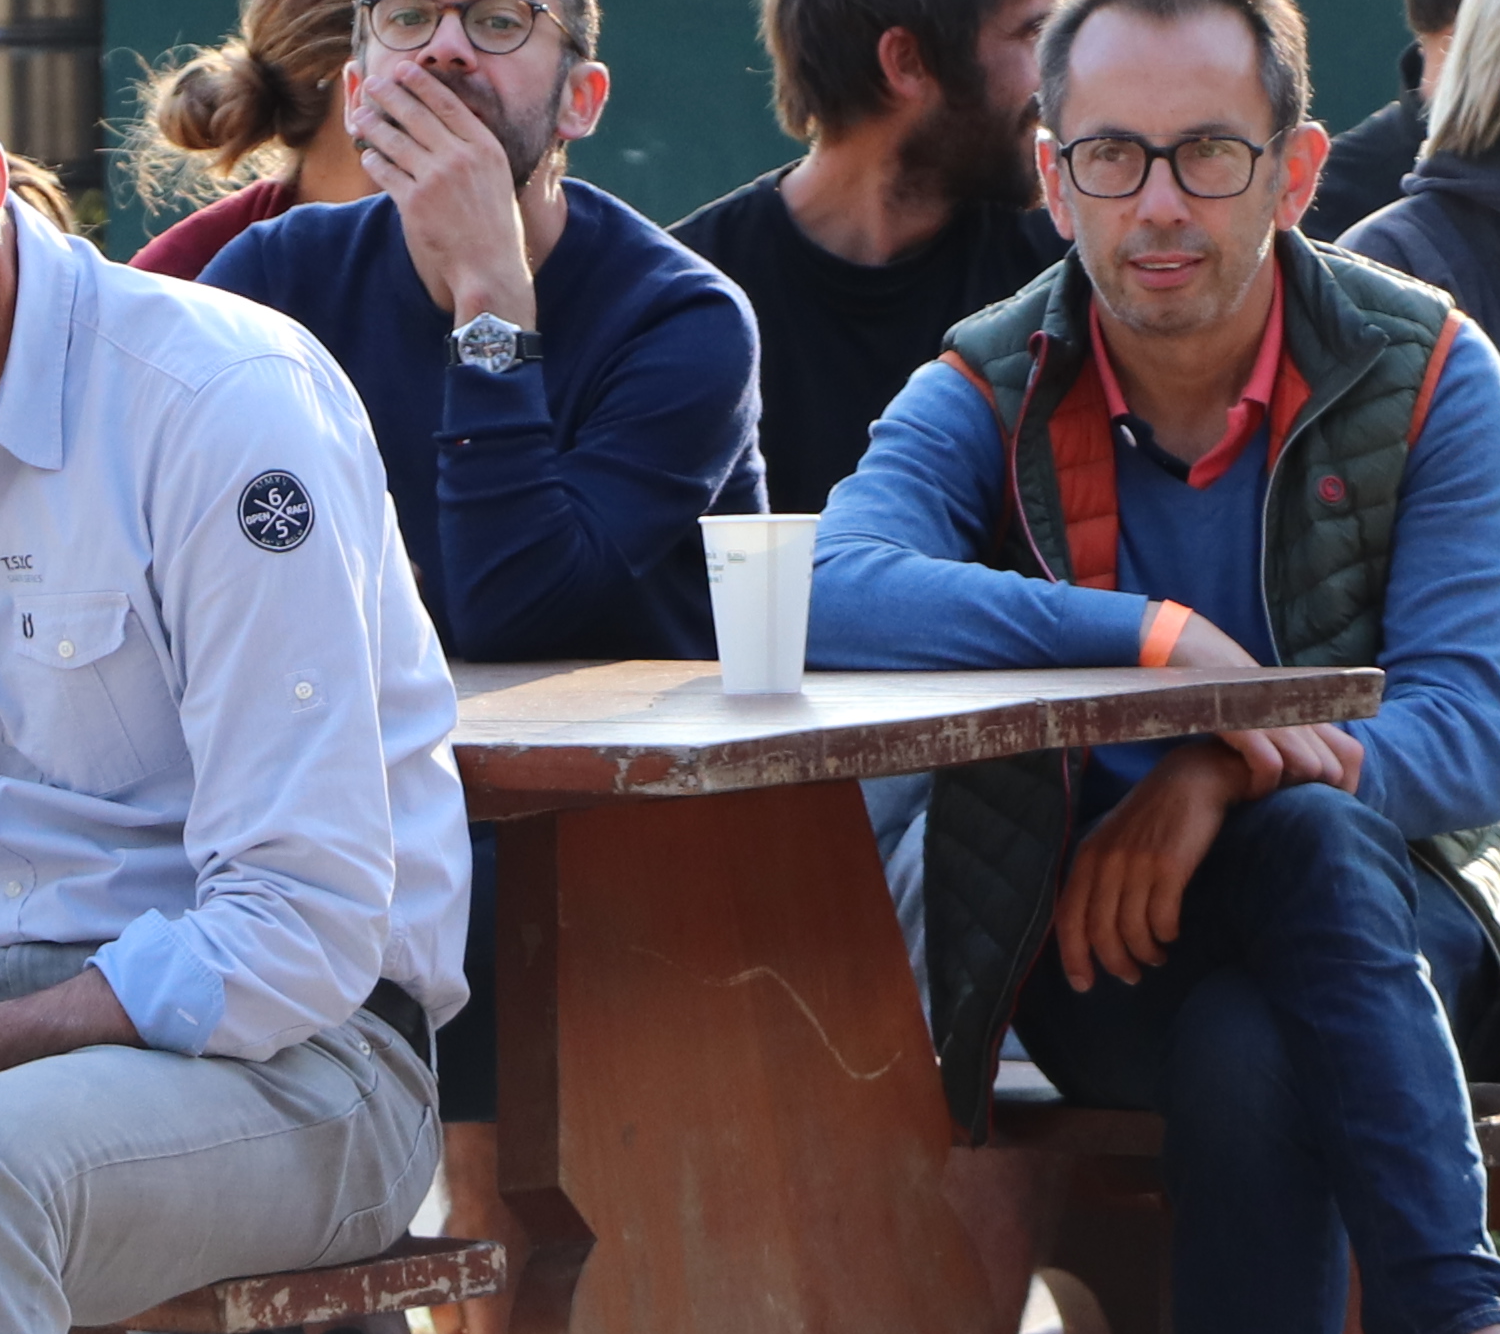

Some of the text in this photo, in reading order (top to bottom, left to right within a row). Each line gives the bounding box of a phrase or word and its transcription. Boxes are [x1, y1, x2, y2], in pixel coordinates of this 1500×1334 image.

[268, 487, 283, 506] 6
[245, 502, 308, 525] OPEN RACE
[275, 519, 289, 539] 5
